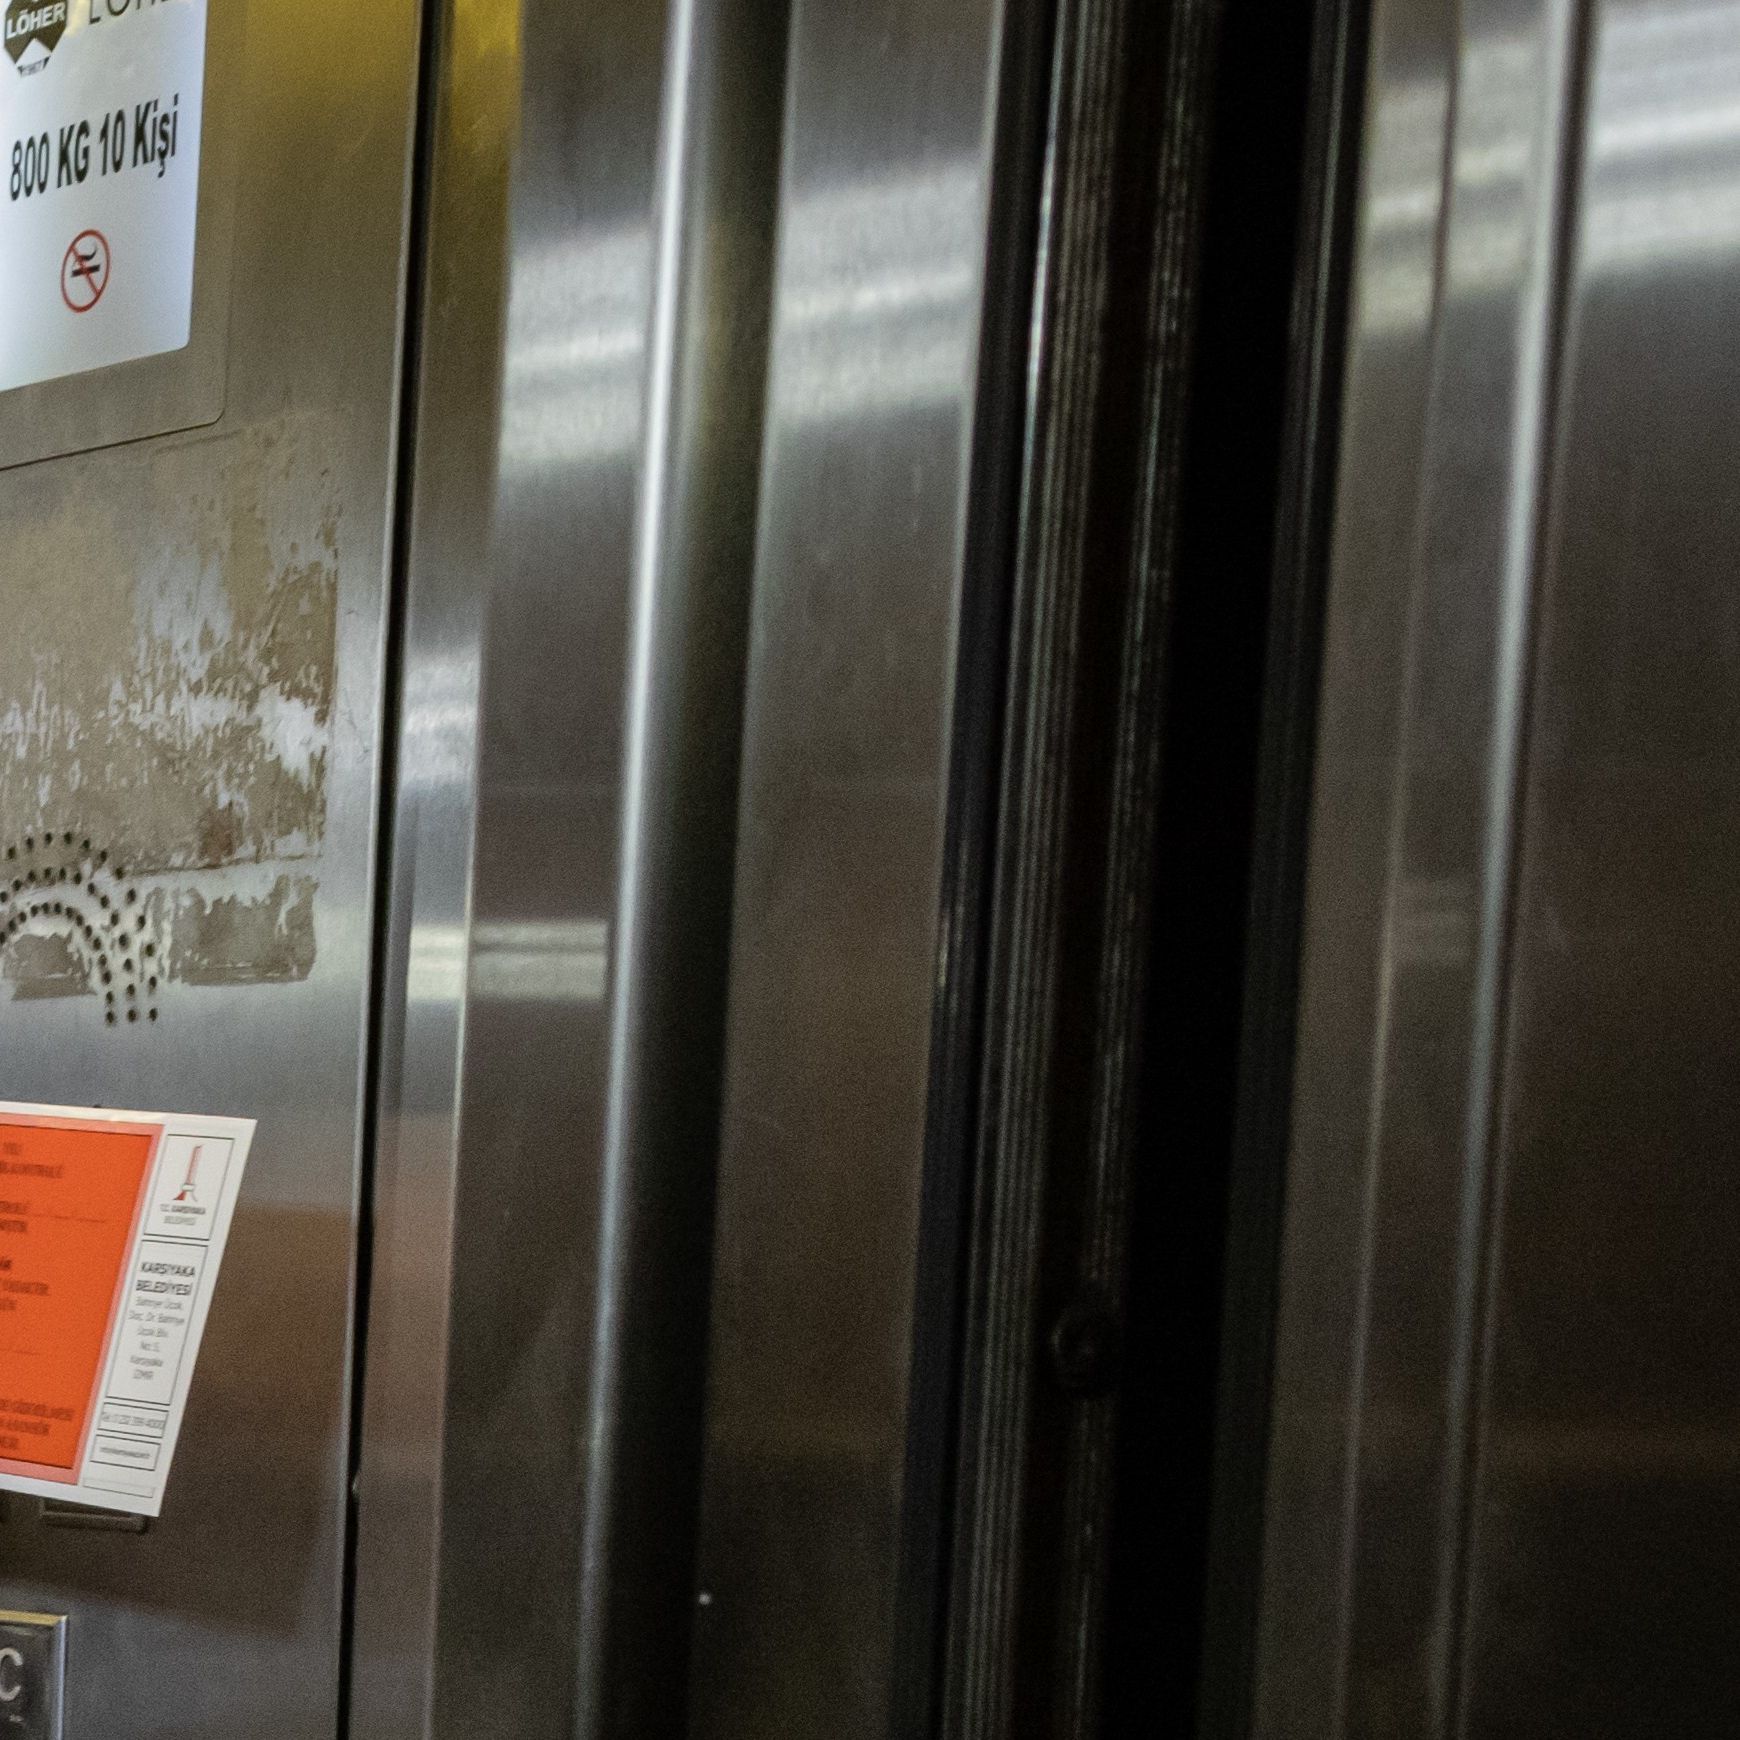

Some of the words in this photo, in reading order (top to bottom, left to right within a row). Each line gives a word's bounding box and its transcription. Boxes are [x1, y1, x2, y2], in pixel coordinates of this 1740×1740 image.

[10, 133, 50, 201] 800
[57, 119, 91, 188] KG
[99, 109, 126, 177] 10
[132, 93, 180, 178] Kişi
